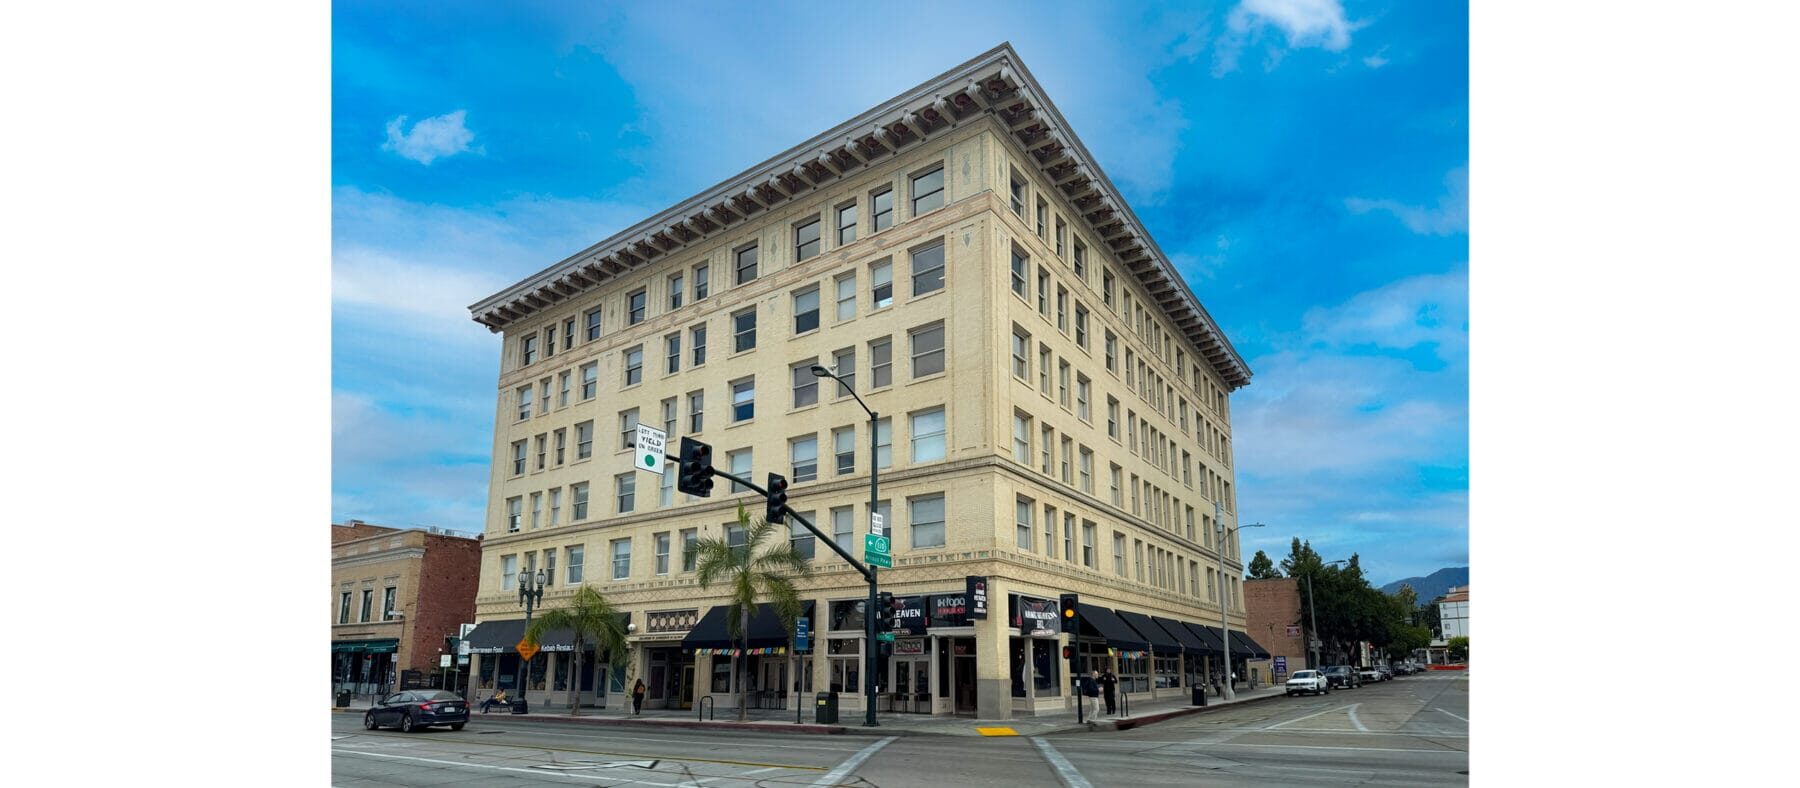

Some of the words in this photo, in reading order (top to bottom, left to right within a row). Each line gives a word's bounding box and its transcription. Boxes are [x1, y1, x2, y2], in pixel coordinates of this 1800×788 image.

[641, 436, 662, 446] YIELD
[893, 609, 921, 619] EAVEN
[541, 644, 556, 652] Kebab
